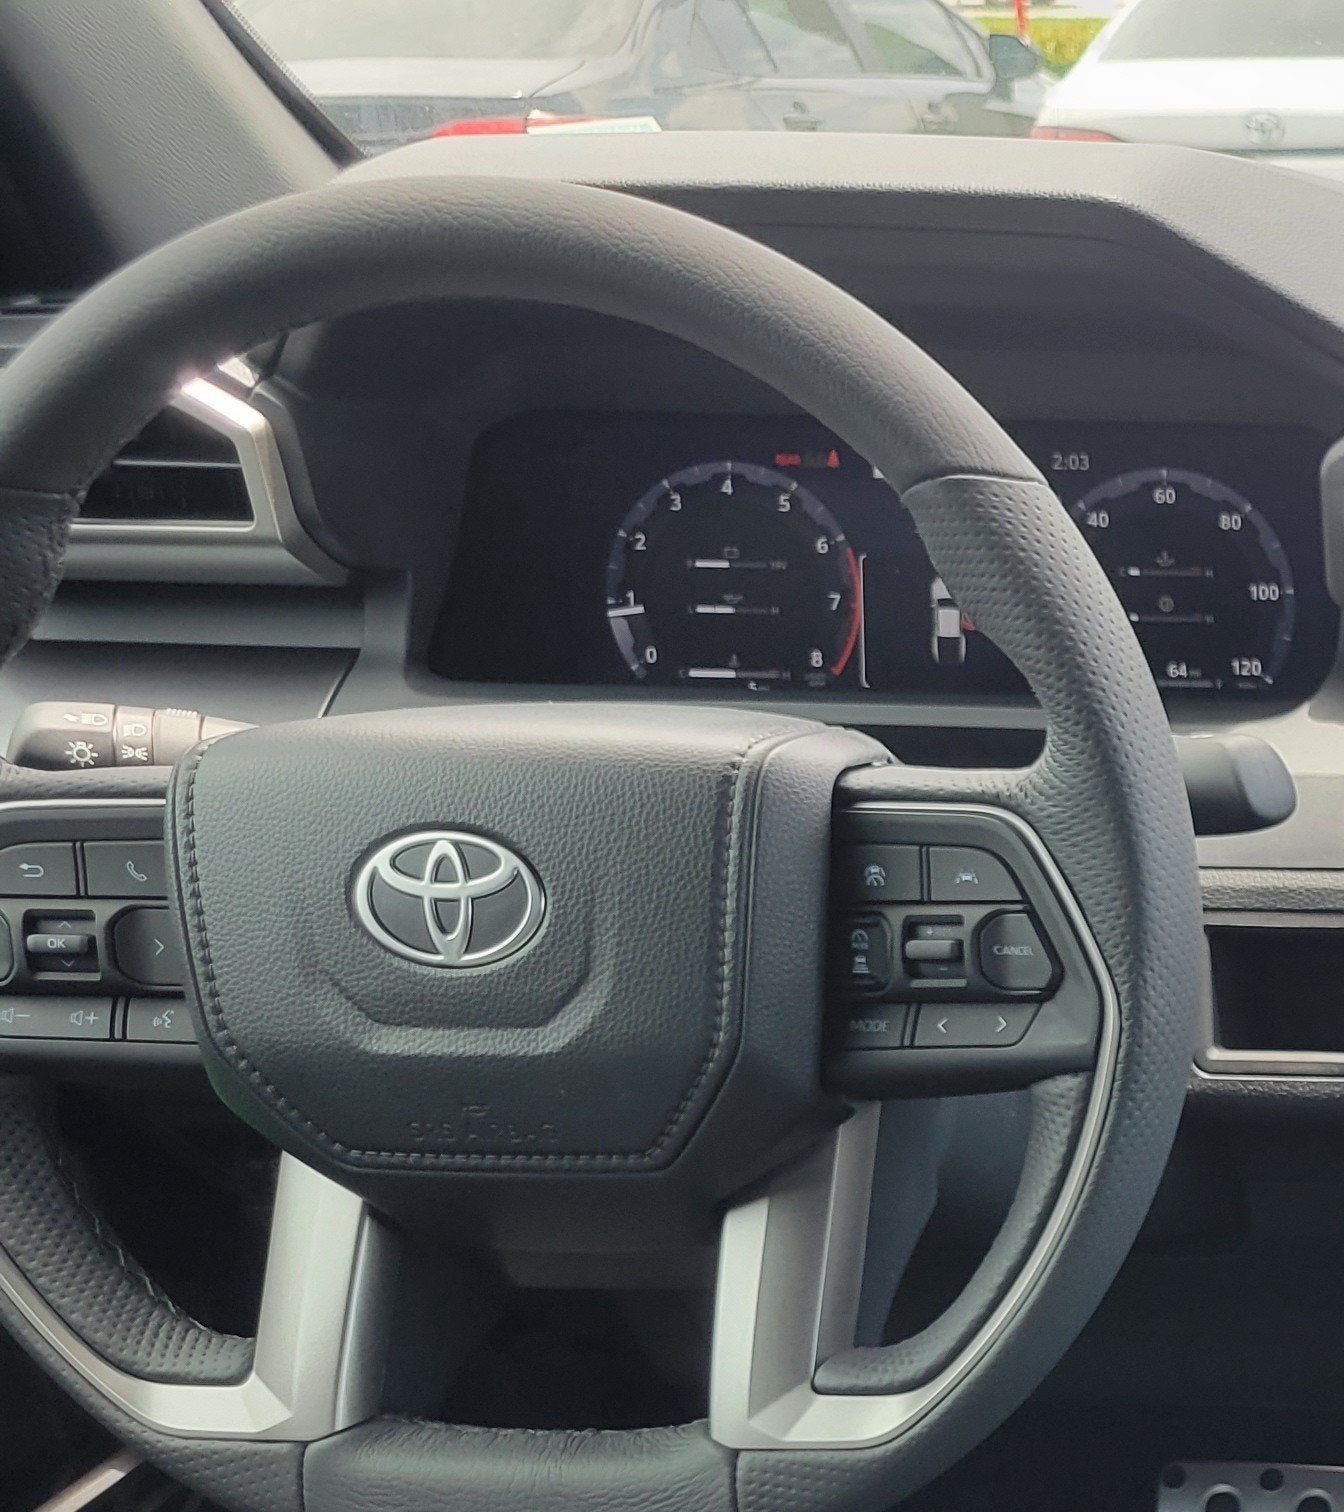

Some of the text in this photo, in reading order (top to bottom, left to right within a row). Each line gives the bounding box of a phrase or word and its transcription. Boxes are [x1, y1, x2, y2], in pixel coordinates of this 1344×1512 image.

[1052, 452, 1090, 471] 2:03
[720, 478, 734, 496] 4
[1153, 487, 1176, 504] 60
[669, 492, 682, 512] 3
[777, 493, 791, 513] 5
[1086, 511, 1110, 528] 40
[1218, 512, 1242, 530] 80
[634, 532, 647, 551] 2
[815, 536, 829, 554] 6
[827, 591, 841, 611] 7
[1249, 582, 1280, 601] 100
[645, 645, 658, 664] 0
[810, 649, 823, 668] 8
[1166, 660, 1188, 678] 64
[1231, 657, 1262, 676] 120
[47, 938, 66, 949] OK
[993, 944, 1034, 957] CANCEL
